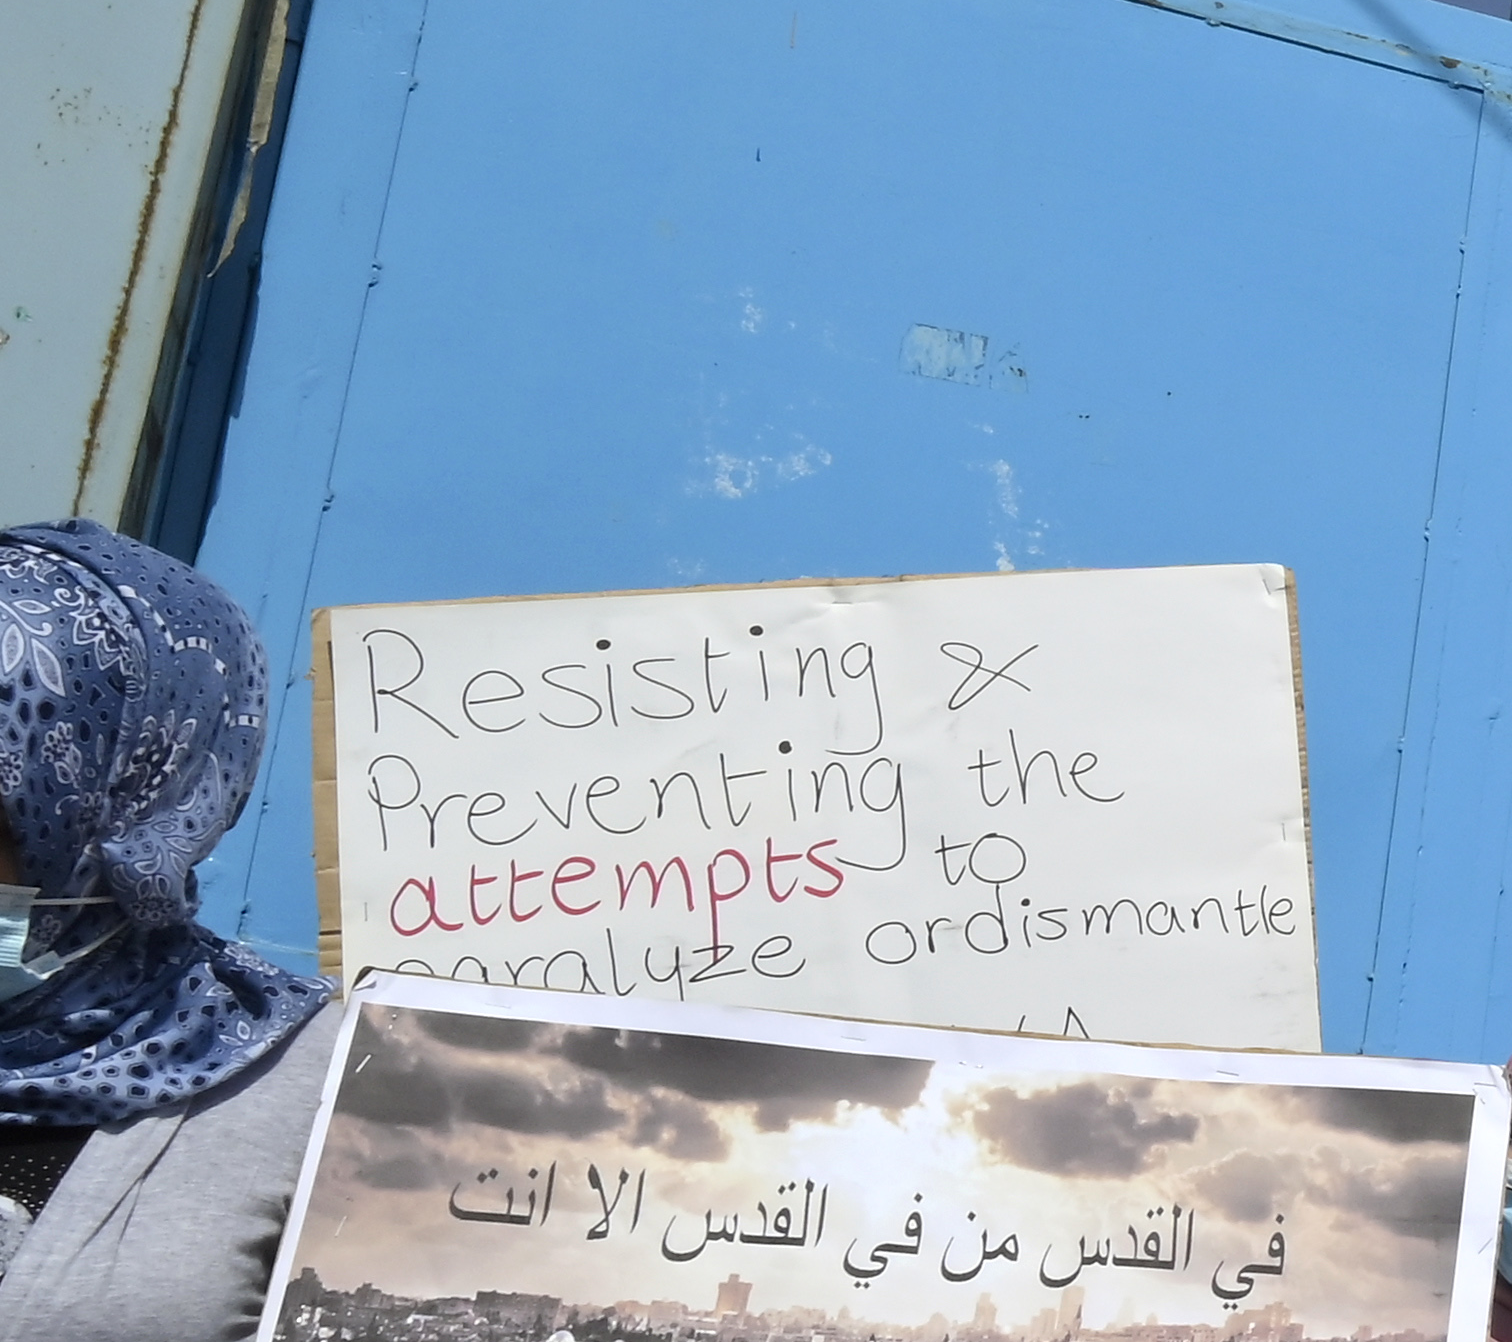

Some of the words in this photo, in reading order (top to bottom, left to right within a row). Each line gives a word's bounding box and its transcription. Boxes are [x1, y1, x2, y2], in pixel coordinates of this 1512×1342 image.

[363, 624, 884, 755] Resisting
[940, 639, 1039, 710] &
[368, 741, 905, 871] Preventing
[967, 731, 1124, 809] the
[389, 835, 844, 961] attempts
[935, 833, 1025, 886] to
[662, 1177, 828, 1262] القدس
[843, 1191, 922, 1288] في
[940, 1211, 1020, 1283] من
[1039, 1207, 1195, 1288] القدس
[1211, 1213, 1286, 1309] في
